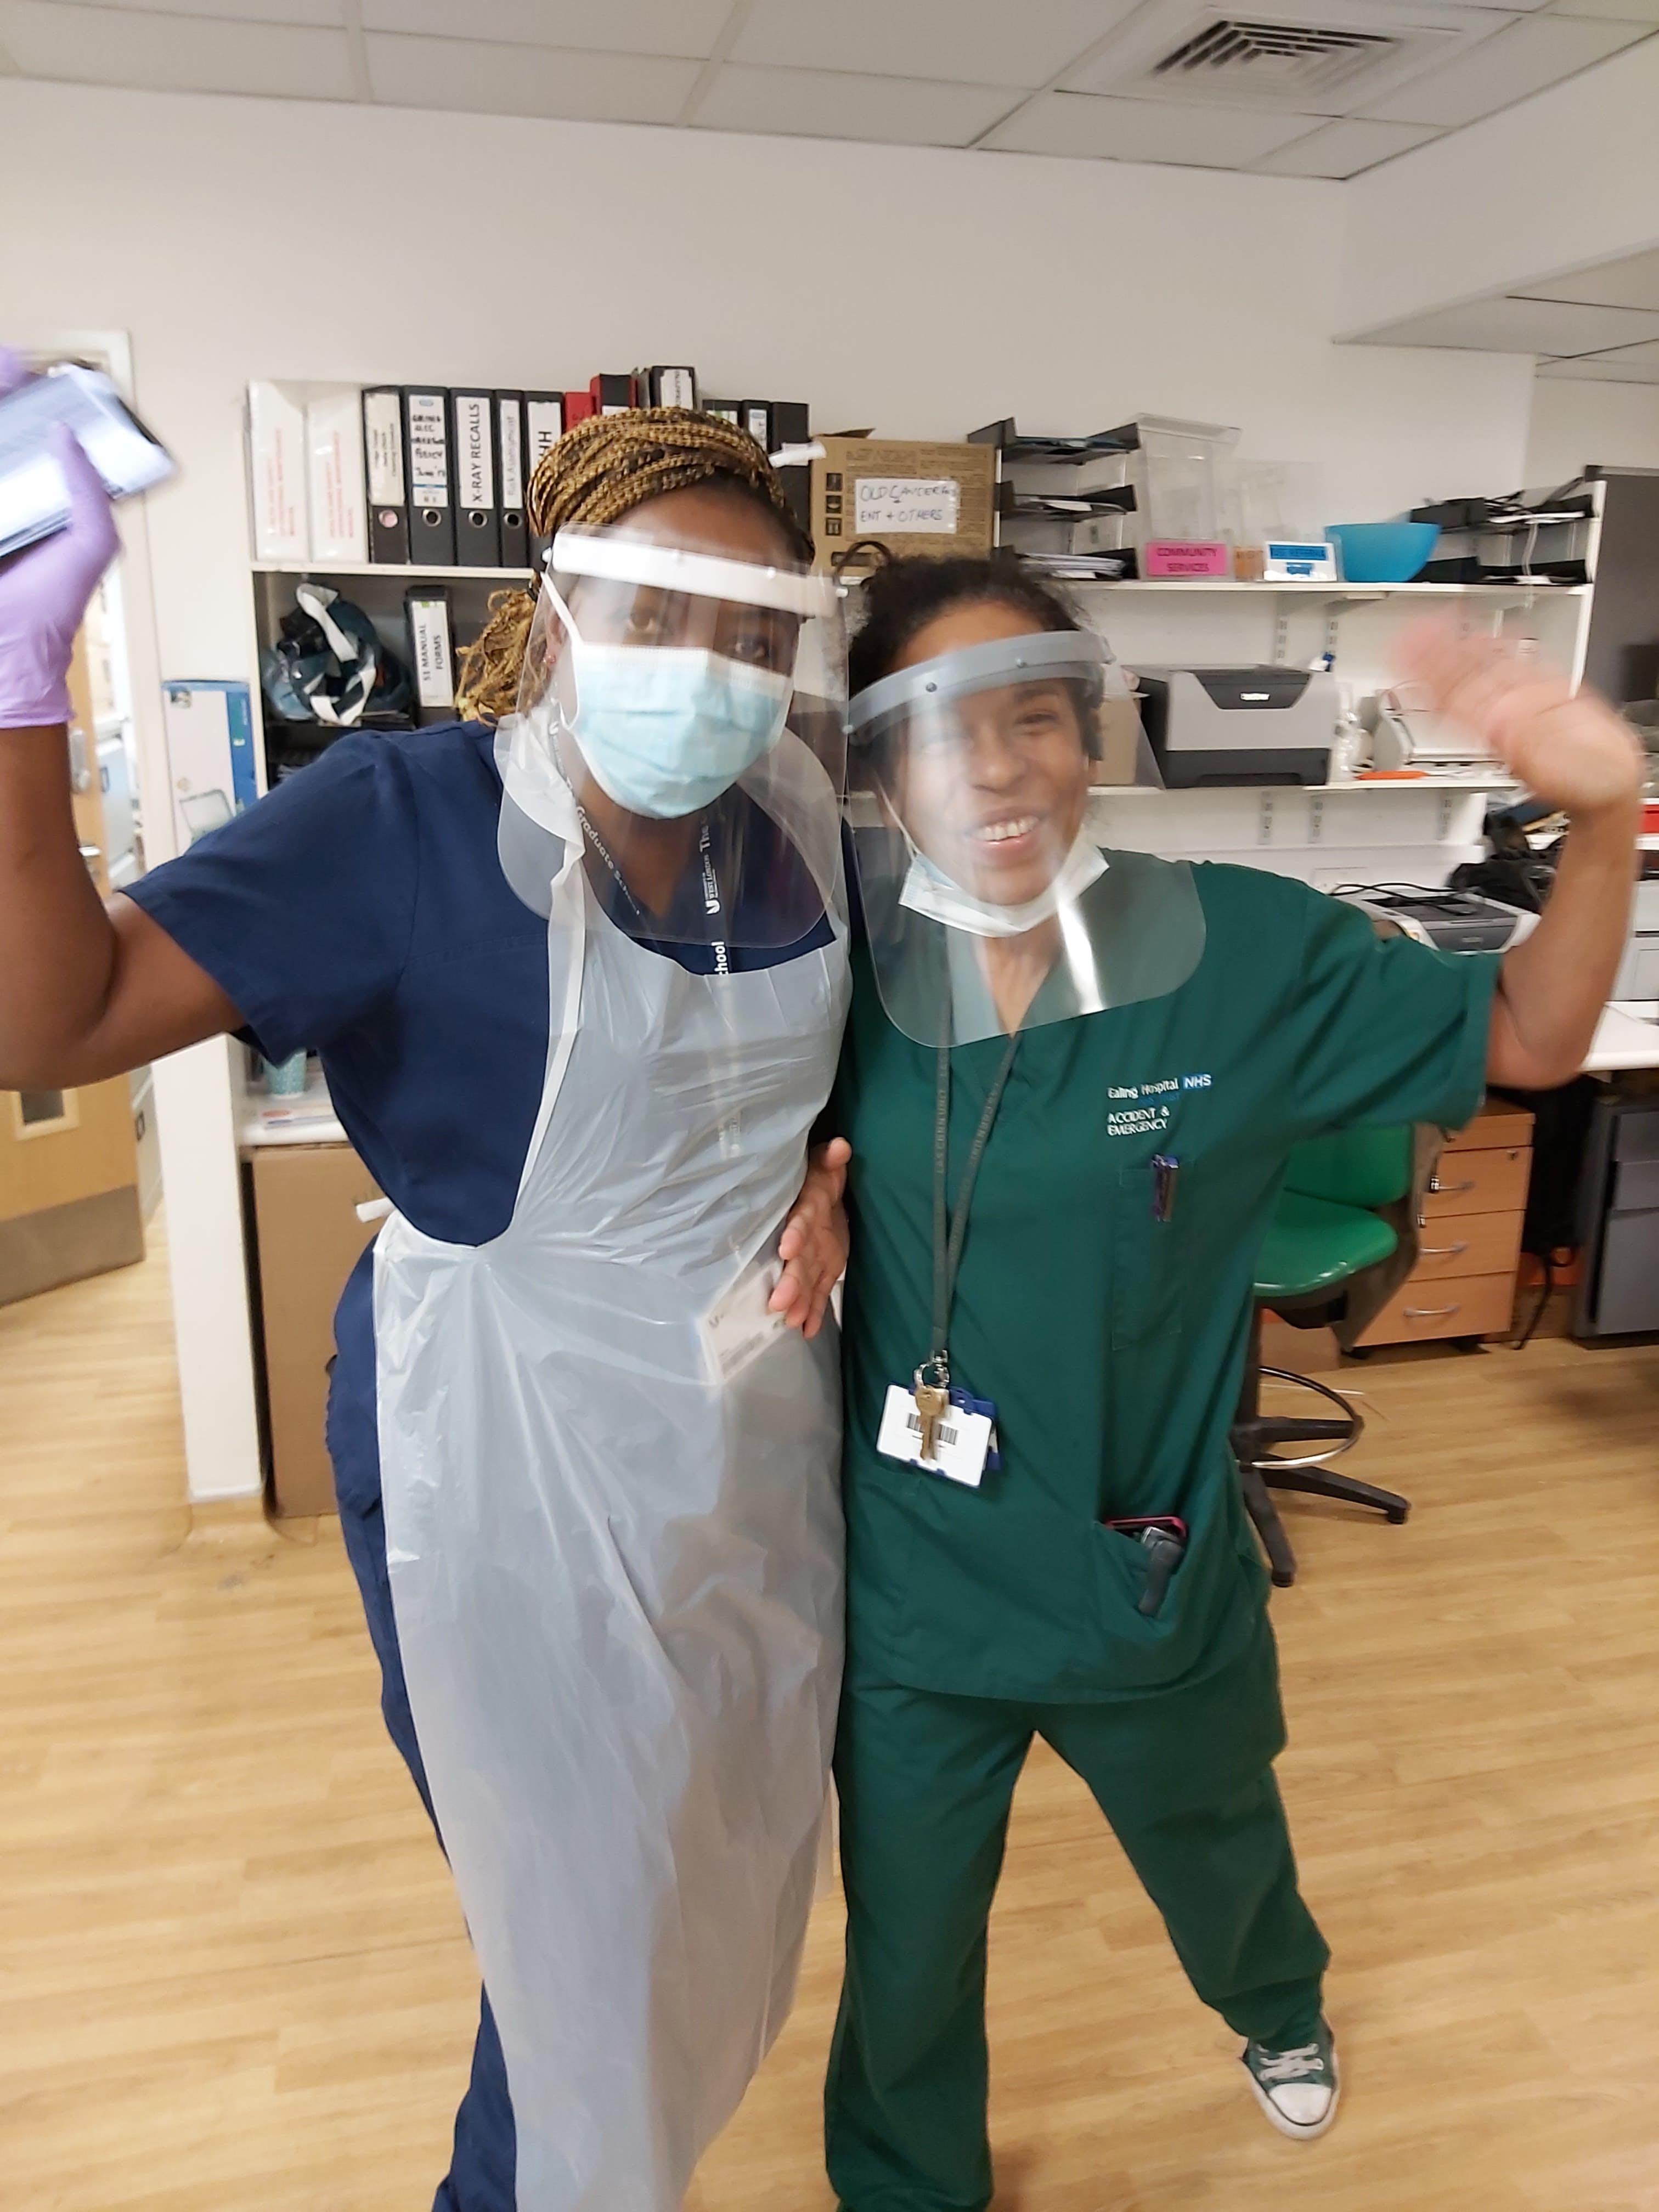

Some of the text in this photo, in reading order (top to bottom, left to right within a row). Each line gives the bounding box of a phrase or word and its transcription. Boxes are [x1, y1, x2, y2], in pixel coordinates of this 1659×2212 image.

[469, 403, 483, 502] X-RAY RECALLS
[860, 485, 887, 501] OLD
[860, 510, 882, 522] ENT
[897, 509, 943, 522] OTHERS
[419, 624, 430, 668] MANUAL
[433, 635, 444, 670] FORMS
[576, 805, 614, 870] Graduate
[699, 825, 711, 853] The
[1107, 1086, 1139, 1099] Ealing
[1141, 1078, 1180, 1095] Hospital
[1184, 1074, 1212, 1088] NHS
[1107, 1105, 1171, 1124] ACCIDENT &
[1107, 1119, 1168, 1136] EMERGENCY
